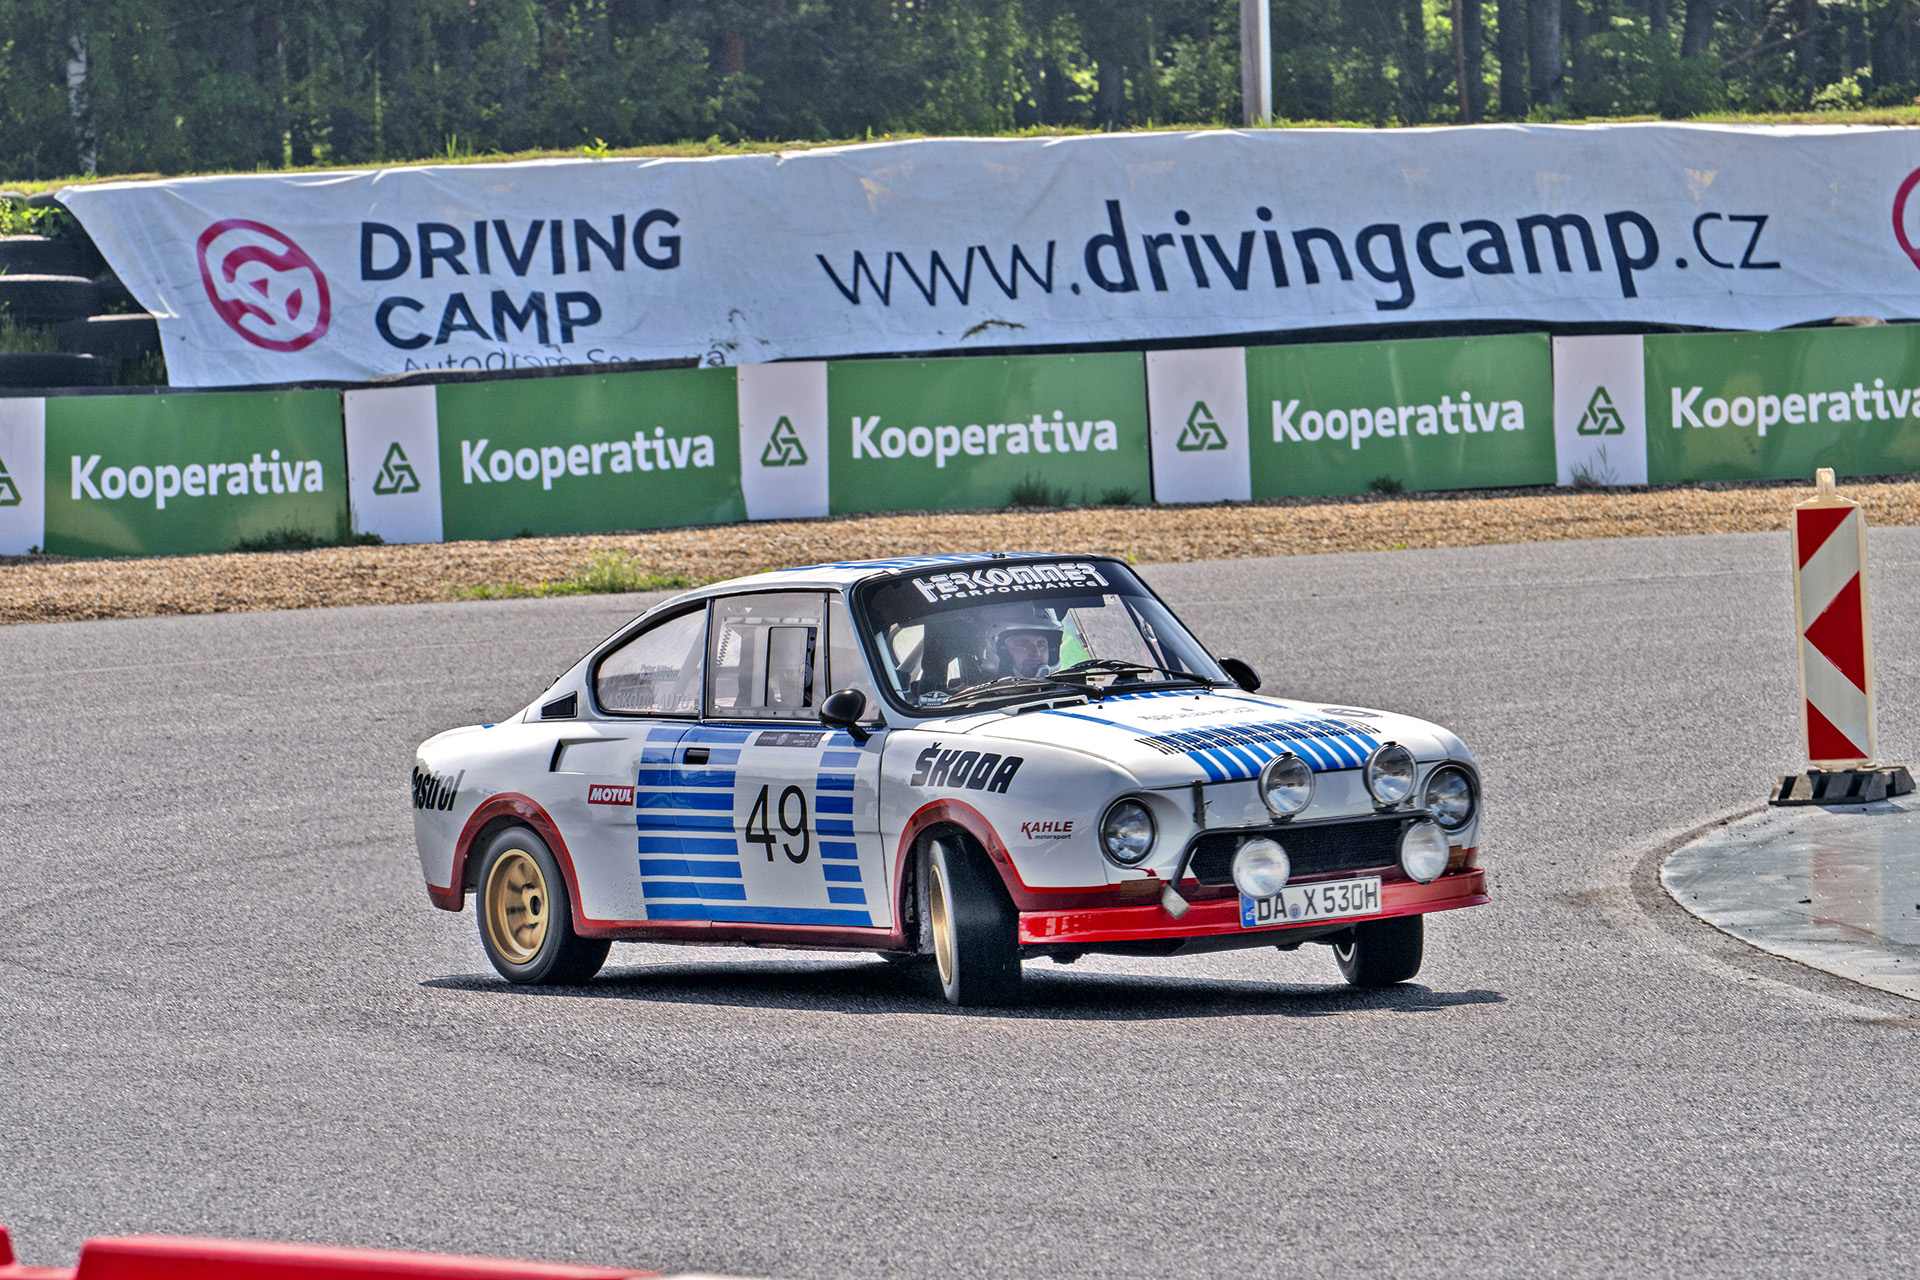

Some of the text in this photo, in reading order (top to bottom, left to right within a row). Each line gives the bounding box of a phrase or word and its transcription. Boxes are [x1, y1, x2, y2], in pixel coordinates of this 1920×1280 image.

[361, 209, 681, 281] DRIVING
[816, 199, 1782, 310] www.drivingcamp.cz
[375, 290, 602, 350] CAMP
[851, 409, 1118, 468] Kooperativa
[1272, 390, 1525, 450] Kooperativa
[71, 449, 323, 509] Kooperativa
[461, 426, 714, 490] Kooperativa
[941, 580, 1098, 600] PERFORMANCE
[590, 787, 632, 802] MOTUL
[911, 742, 1024, 794] ŠKODA
[746, 784, 810, 864] 49
[1021, 821, 1073, 839] KAHLE
[1257, 892, 1288, 921] DA
[1304, 888, 1318, 916] X
[1323, 881, 1378, 914] 530H
